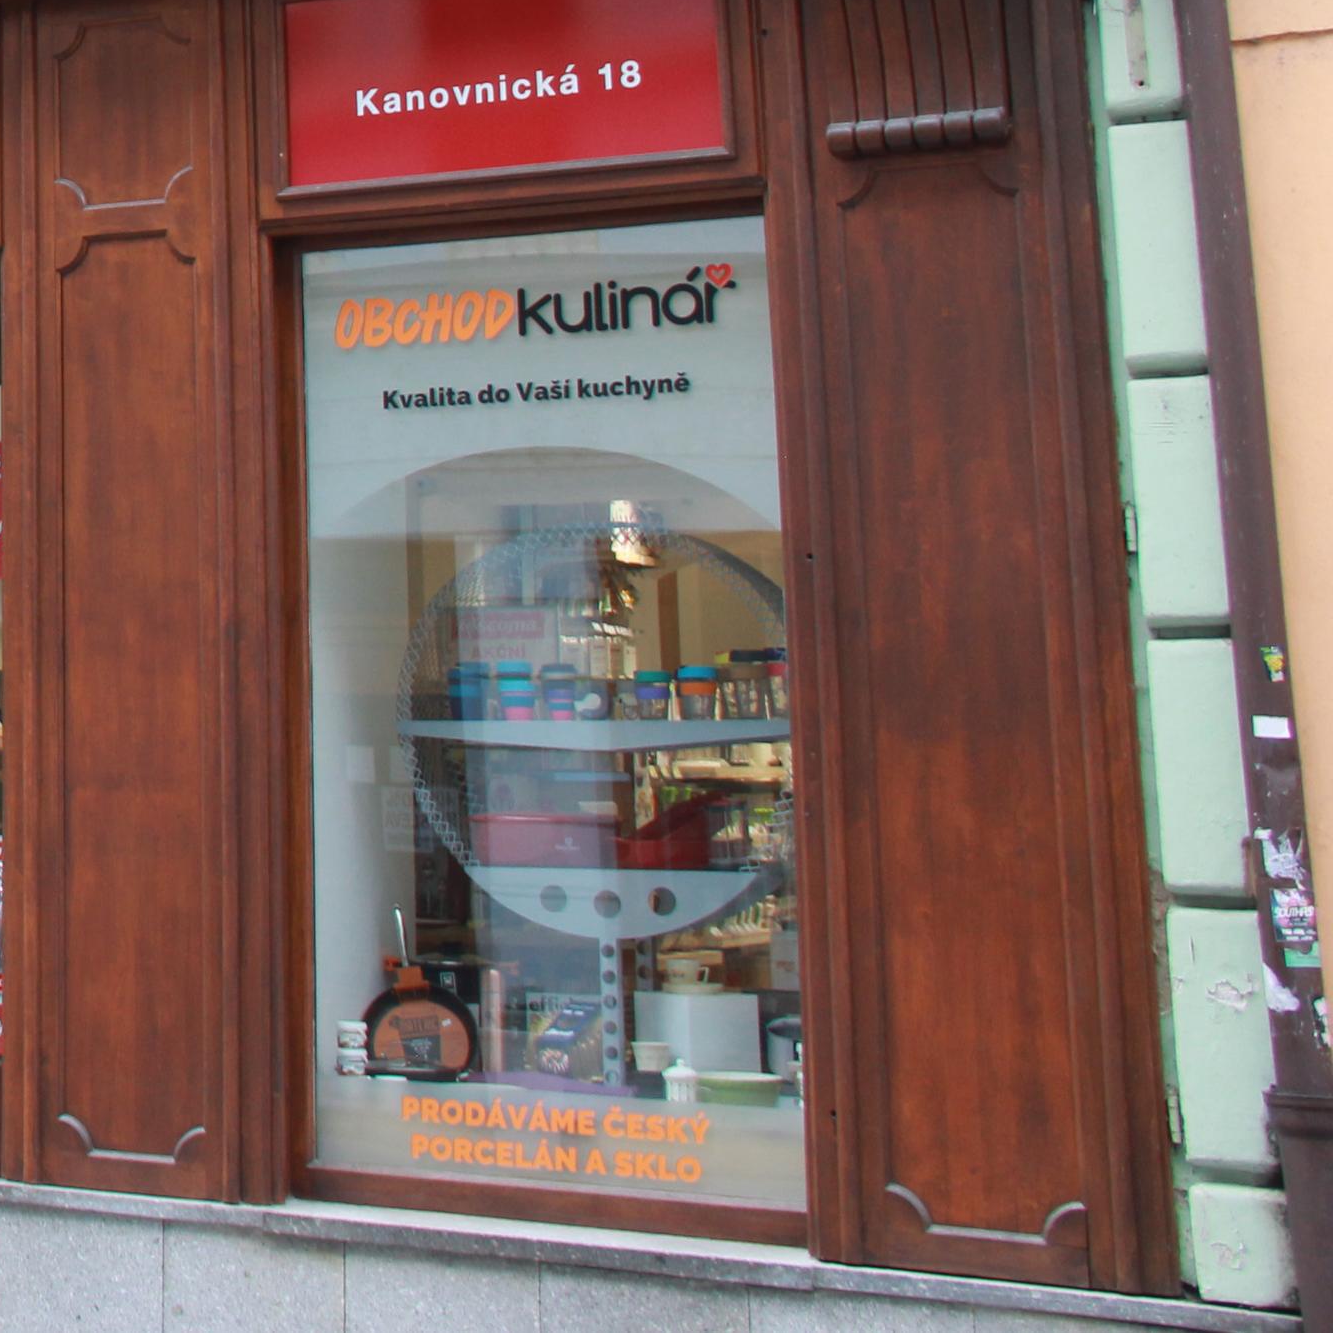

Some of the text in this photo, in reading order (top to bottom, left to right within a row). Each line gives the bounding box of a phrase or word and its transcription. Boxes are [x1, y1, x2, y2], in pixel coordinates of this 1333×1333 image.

[355, 59, 642, 117] Kanovnická 18
[382, 372, 691, 410] Kvalita do Vaší kuchyně
[401, 1095, 710, 1145] PRODÁVÁME ČESKÝ
[410, 1133, 702, 1183] PORCELÁN A SKLO
